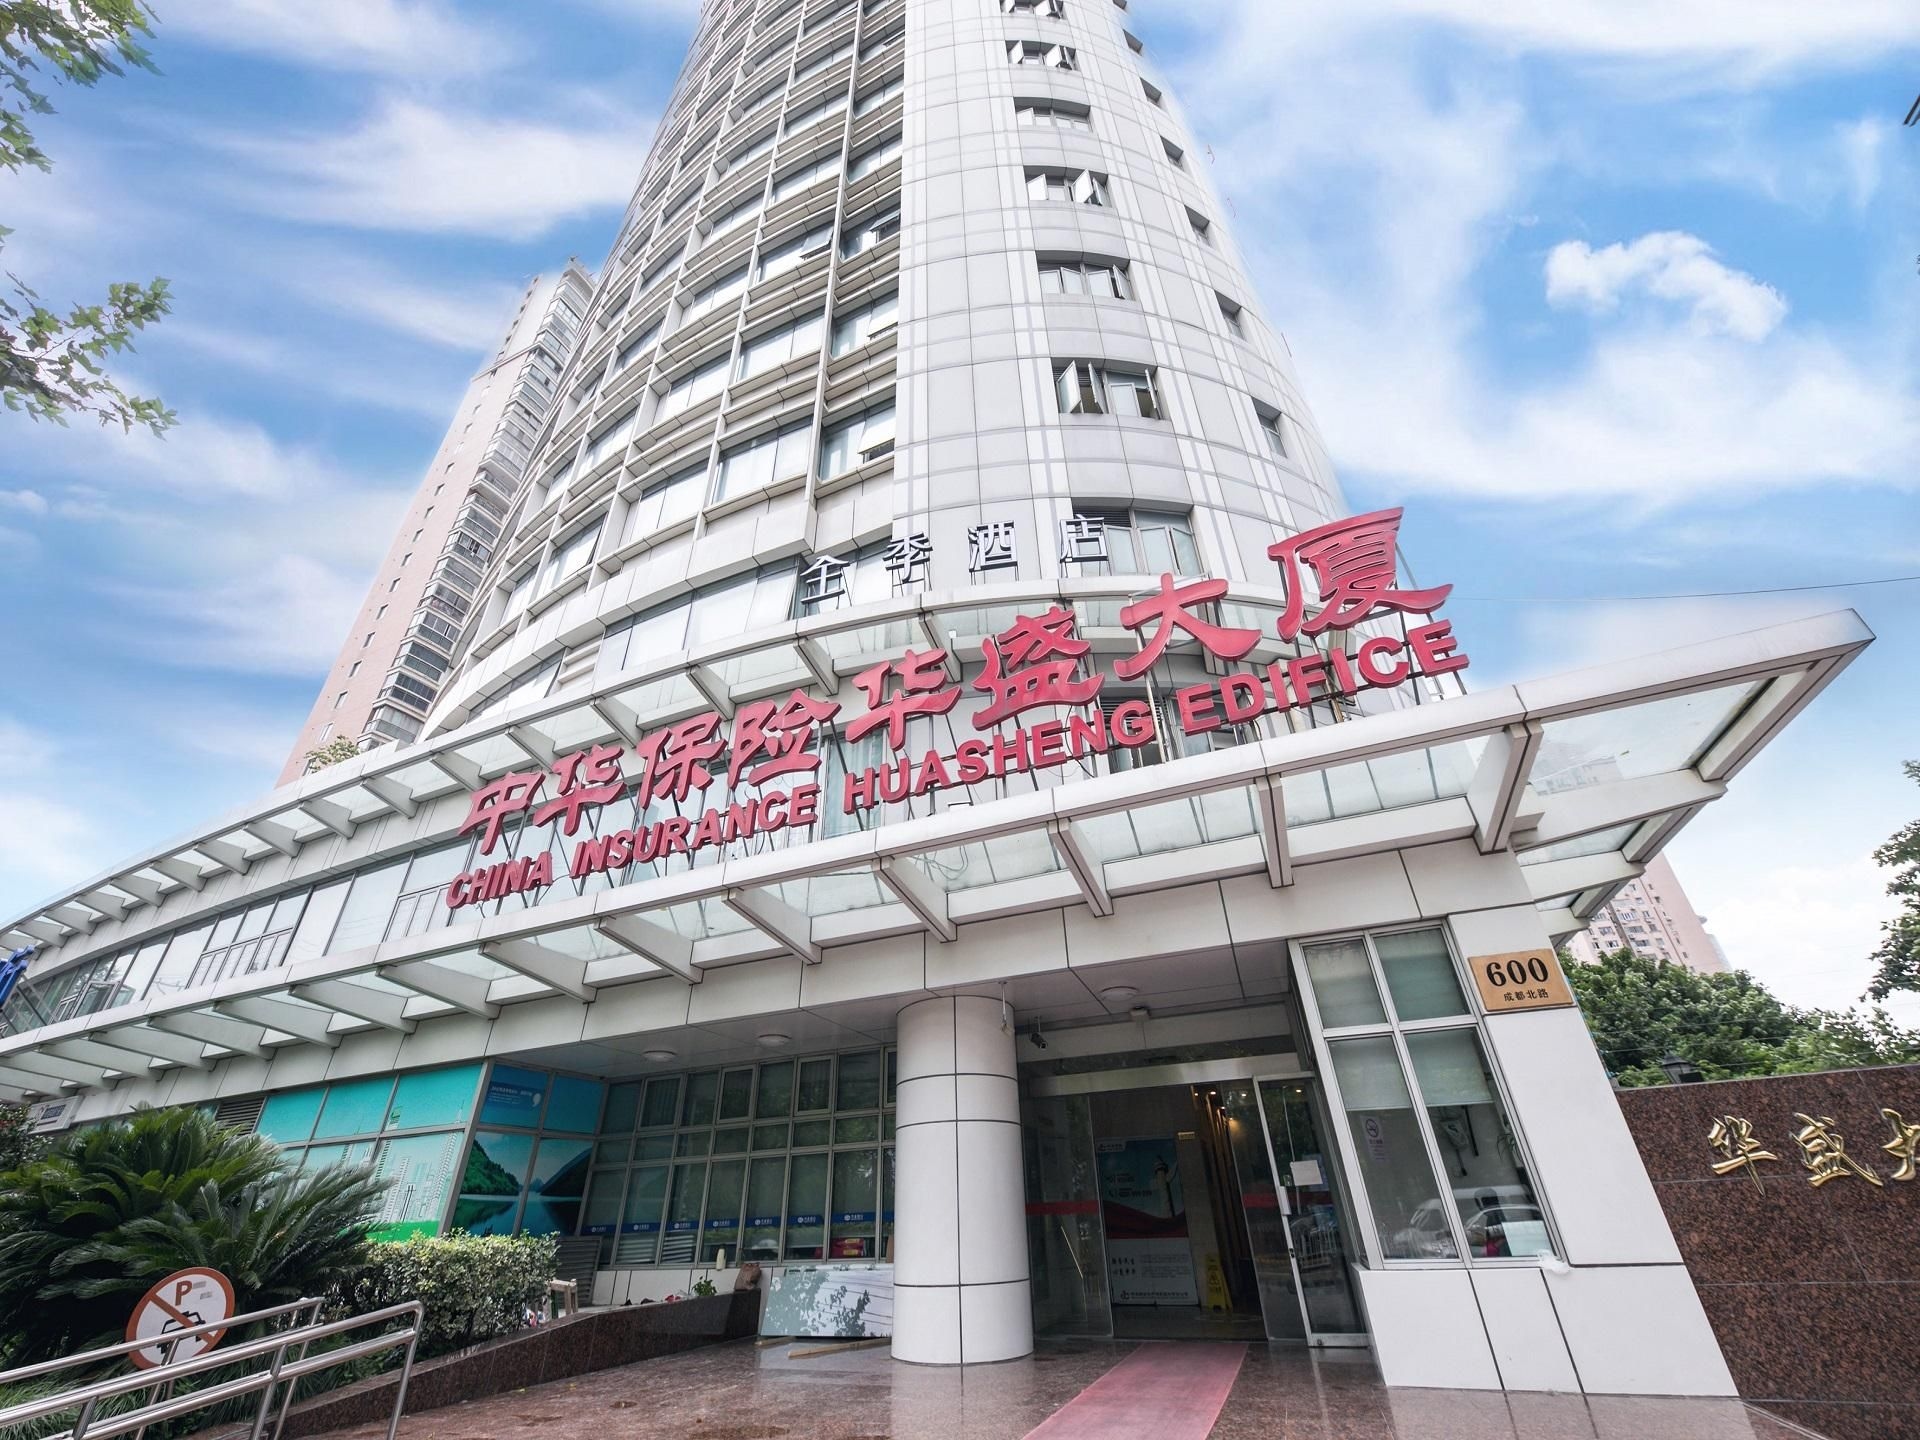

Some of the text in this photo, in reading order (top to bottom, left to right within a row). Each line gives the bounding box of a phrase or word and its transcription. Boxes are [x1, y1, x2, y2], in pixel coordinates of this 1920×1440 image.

[800, 514, 1109, 604] 全季酒店
[459, 507, 1454, 856] 中华保险华盛大厦
[447, 619, 1469, 909] CHINA INSURANCE HUASHENG EDIFICE
[1486, 957, 1549, 987] 600
[1503, 988, 1549, 1002] 成都北路
[175, 1280, 193, 1306] P
